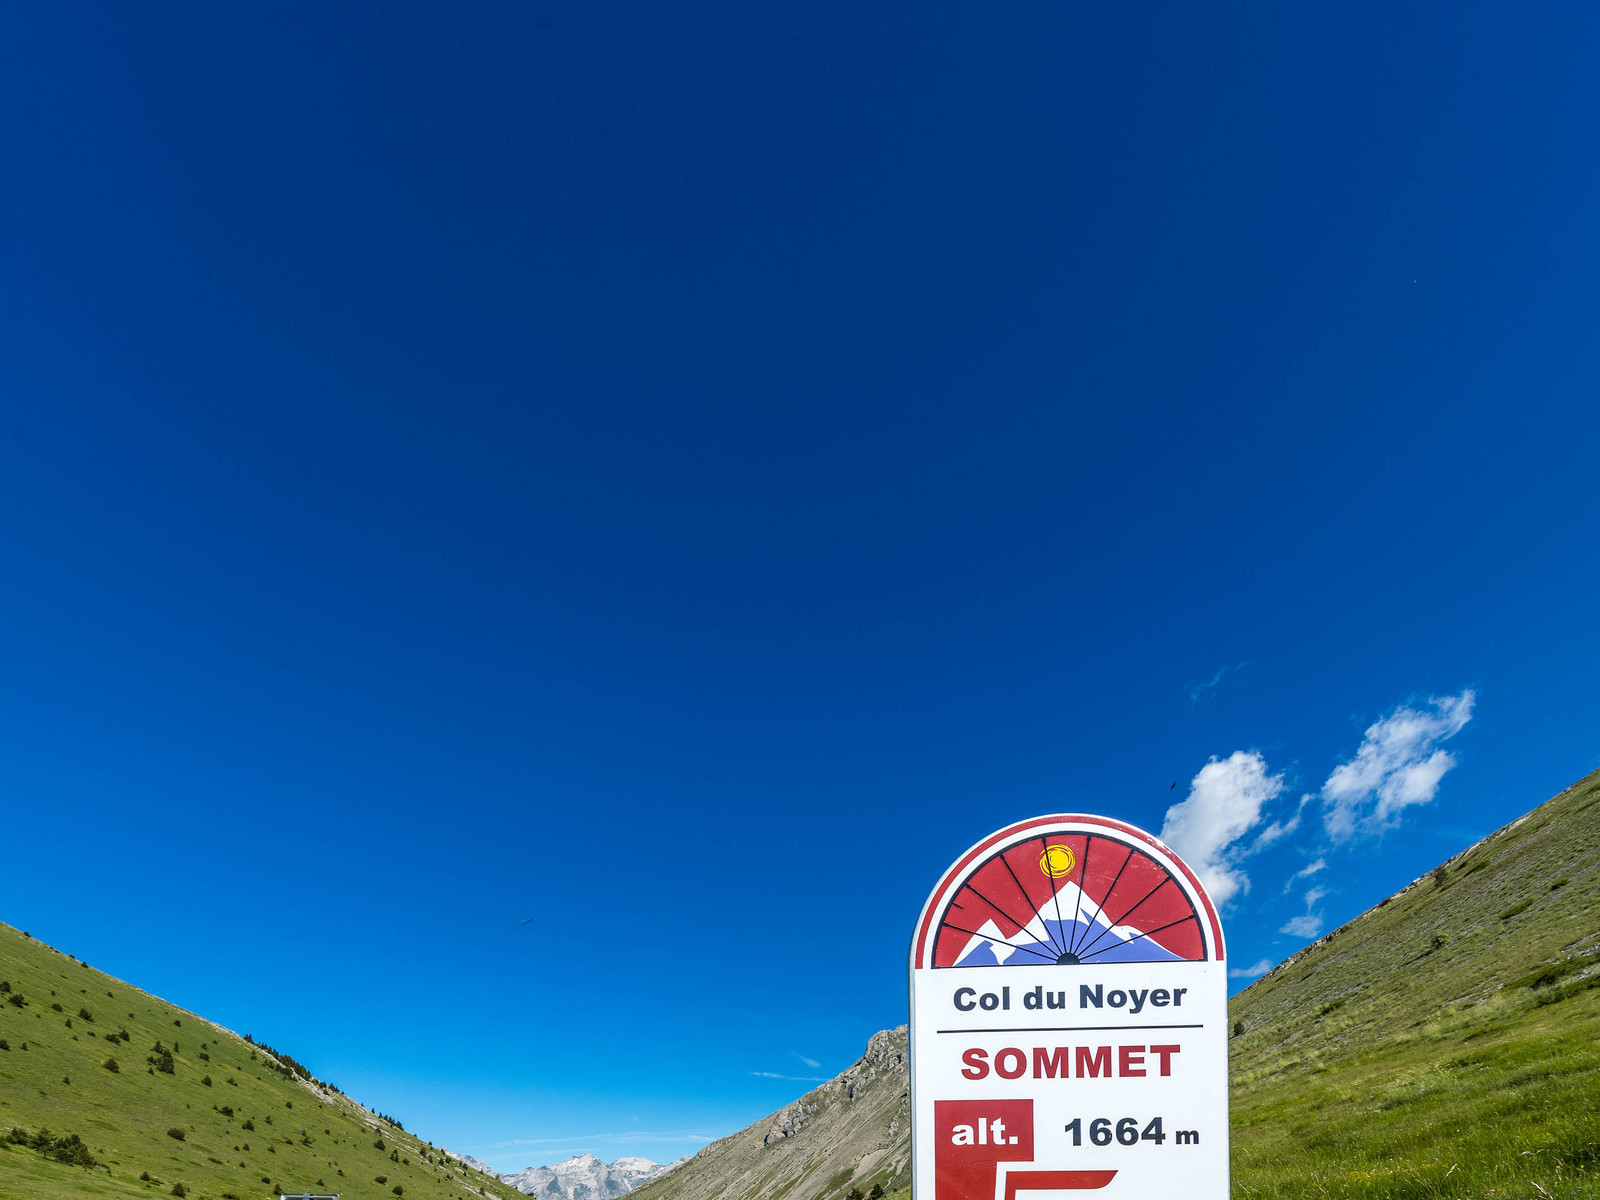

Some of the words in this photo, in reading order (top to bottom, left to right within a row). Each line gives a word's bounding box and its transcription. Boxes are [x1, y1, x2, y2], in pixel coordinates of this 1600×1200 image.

[953, 986, 1011, 1012] Col
[1023, 985, 1066, 1010] du
[1079, 983, 1188, 1015] Noyer
[960, 1044, 1181, 1081] SOMMET
[951, 1117, 1019, 1146] alt.
[1064, 1116, 1166, 1147] 1664
[1175, 1130, 1200, 1145] m
